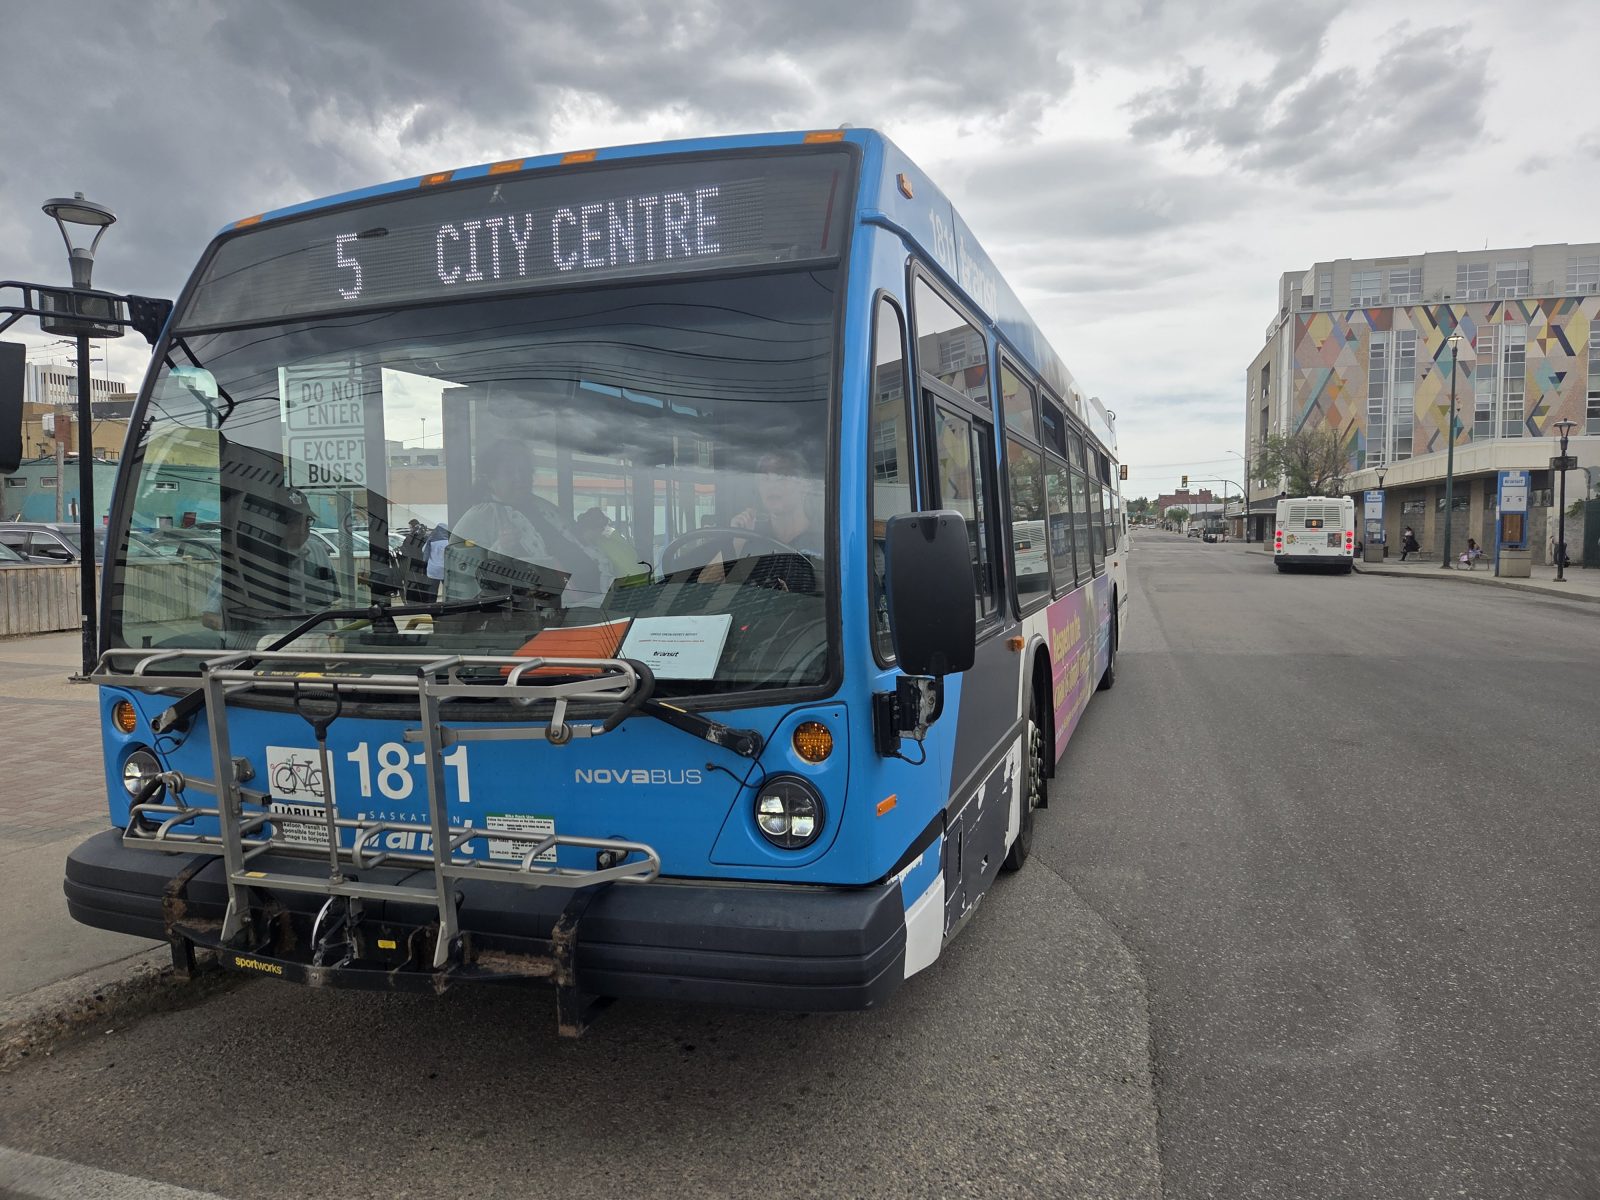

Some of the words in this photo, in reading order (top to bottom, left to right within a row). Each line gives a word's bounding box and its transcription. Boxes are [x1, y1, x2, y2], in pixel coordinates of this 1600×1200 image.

[336, 232, 363, 300] 5
[437, 213, 534, 285] CITY
[552, 187, 720, 271] CENTRE
[302, 382, 324, 402] DO
[307, 402, 361, 426] ENTER
[303, 439, 365, 461] EXCEPT
[308, 462, 364, 484] BUSES
[274, 805, 326, 818] LIABILIT
[369, 810, 460, 824] SASKATN
[235, 956, 283, 975] sportworks
